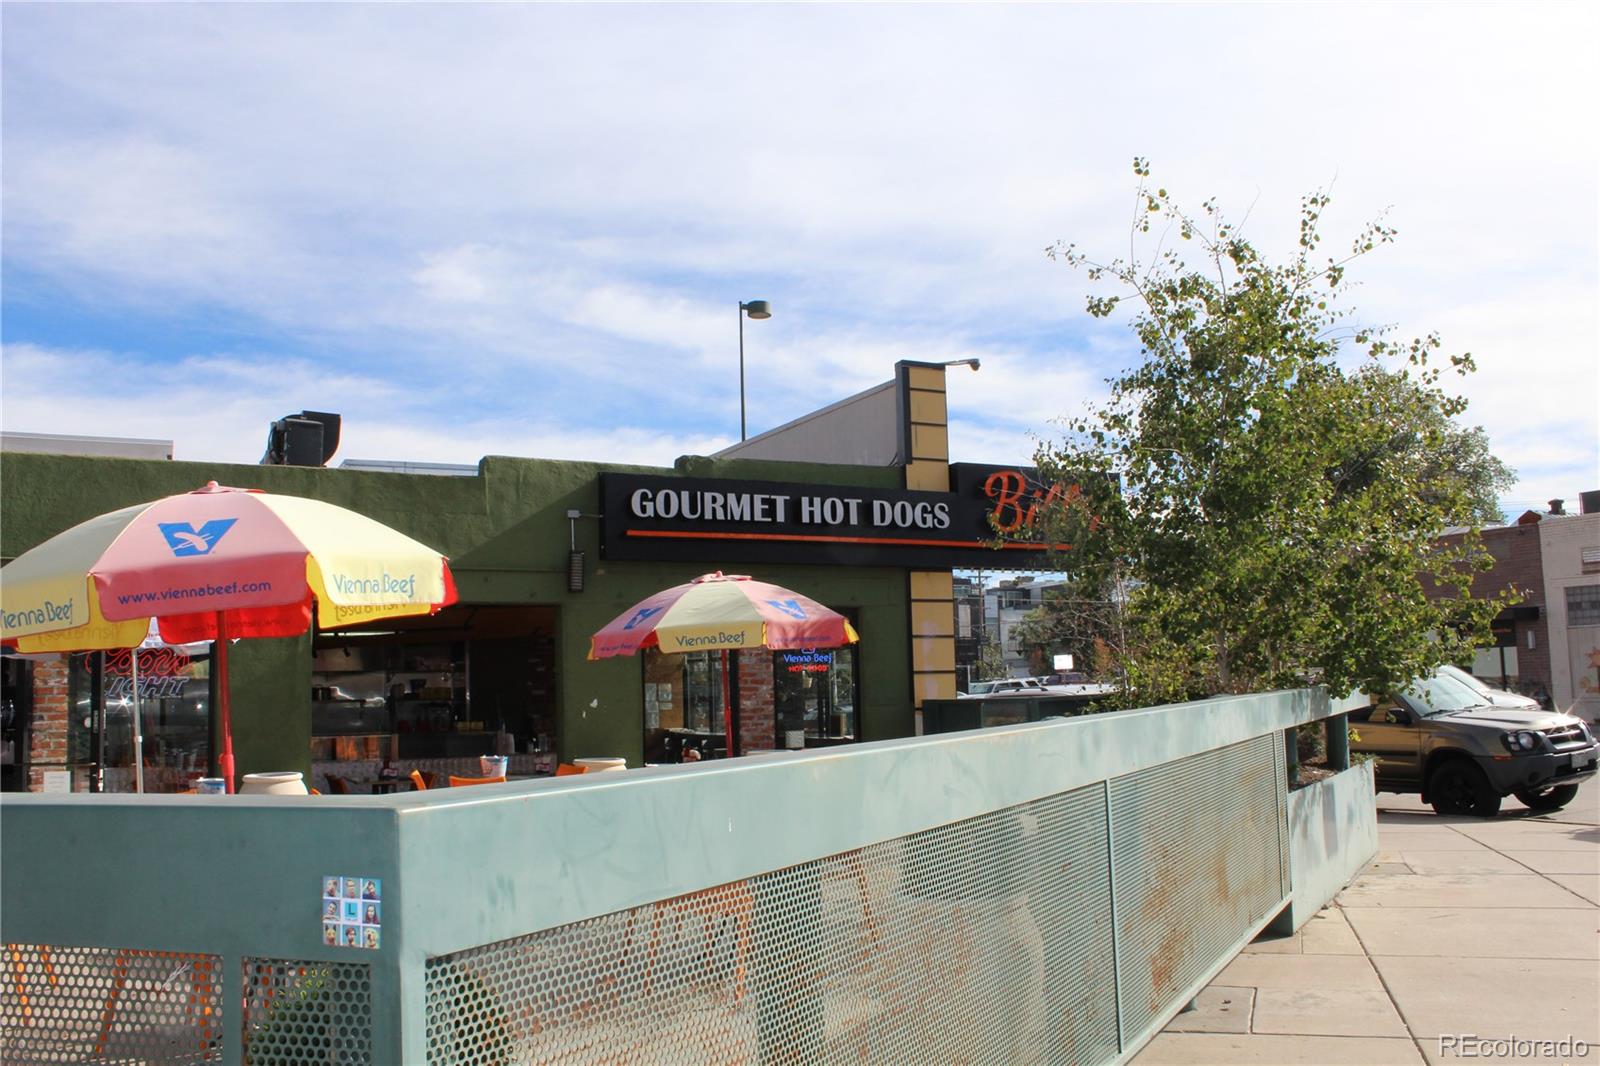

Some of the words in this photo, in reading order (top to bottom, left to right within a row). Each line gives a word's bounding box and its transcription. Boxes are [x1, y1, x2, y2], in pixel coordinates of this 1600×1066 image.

[631, 487, 790, 523] GOURMET
[801, 496, 862, 525] HOT
[873, 499, 951, 529] DOGS
[118, 581, 271, 605] www.viennabeef.com
[332, 574, 380, 594] Vienna
[383, 572, 415, 598] Beef
[44, 598, 73, 625] Beef
[675, 635, 717, 647] Vienna
[718, 630, 745, 645] Beef
[783, 653, 811, 663] Vienna
[813, 653, 832, 664] Beef
[104, 675, 190, 698] IGHT
